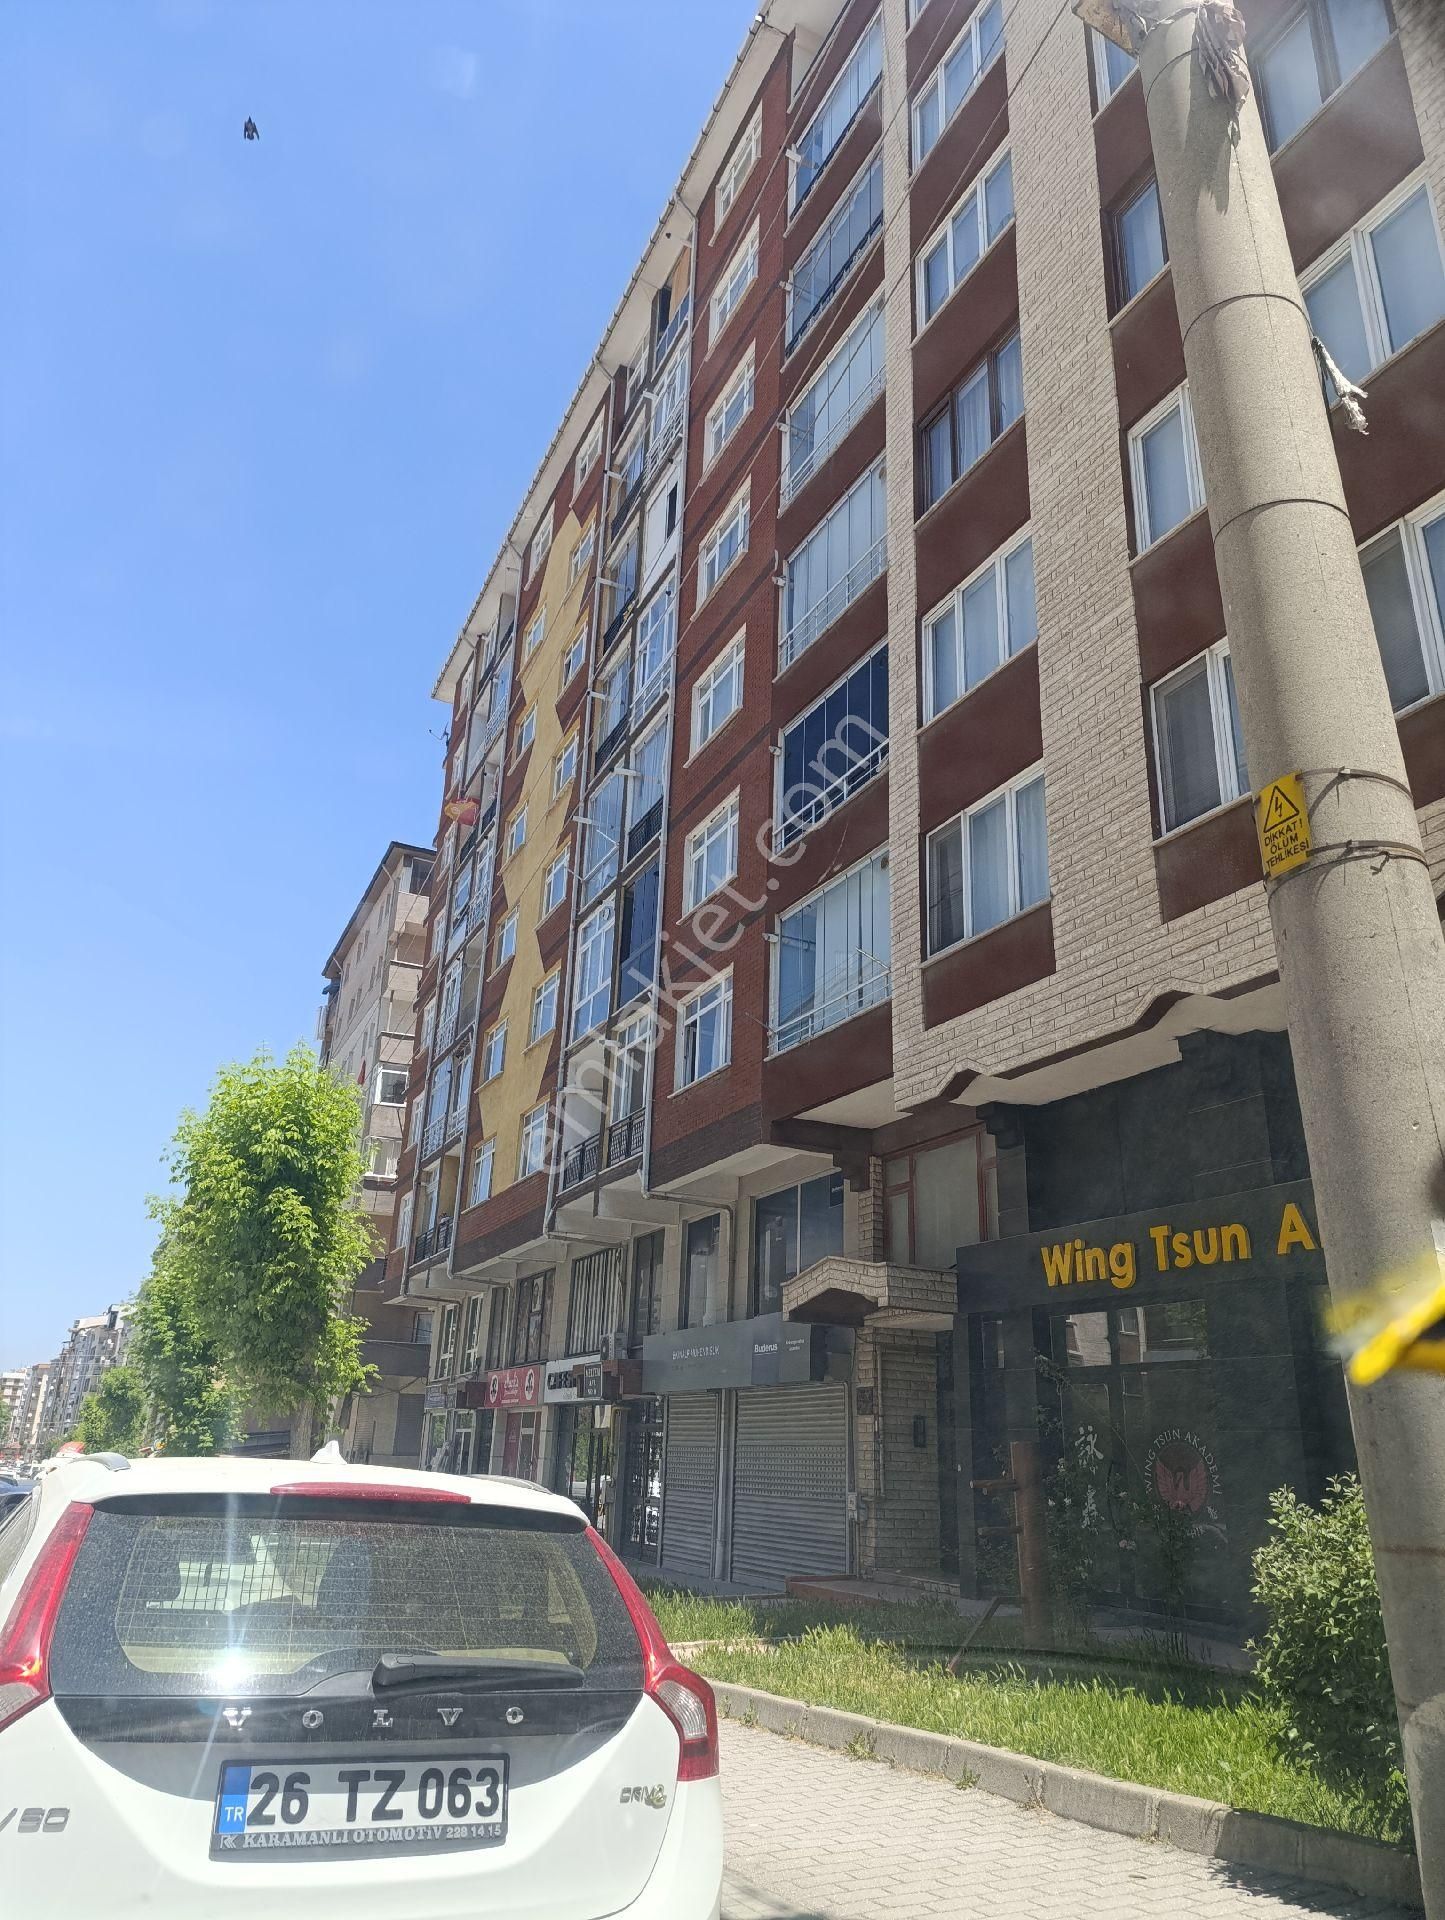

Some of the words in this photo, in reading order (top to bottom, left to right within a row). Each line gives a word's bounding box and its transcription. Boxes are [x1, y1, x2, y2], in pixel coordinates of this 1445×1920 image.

[1265, 837, 1310, 869] TEHLİKESİ
[1270, 833, 1299, 855] ÖLÜM
[1041, 1238, 1136, 1289] Wing
[1149, 1223, 1252, 1271] Tsun
[754, 1343, 778, 1353] Buderus
[1144, 1448, 1156, 1495] WING
[1153, 1428, 1181, 1449] TSUN
[223, 1706, 525, 1732] VOLVO
[246, 1770, 311, 1826] 26
[338, 1769, 406, 1823] TZ
[417, 1767, 500, 1819] 063
[224, 1806, 244, 1822] TR
[243, 1830, 349, 1848] KARAMANLI
[446, 1826, 468, 1839] 228
[471, 1824, 485, 1838] 14
[488, 1823, 501, 1837] 15
